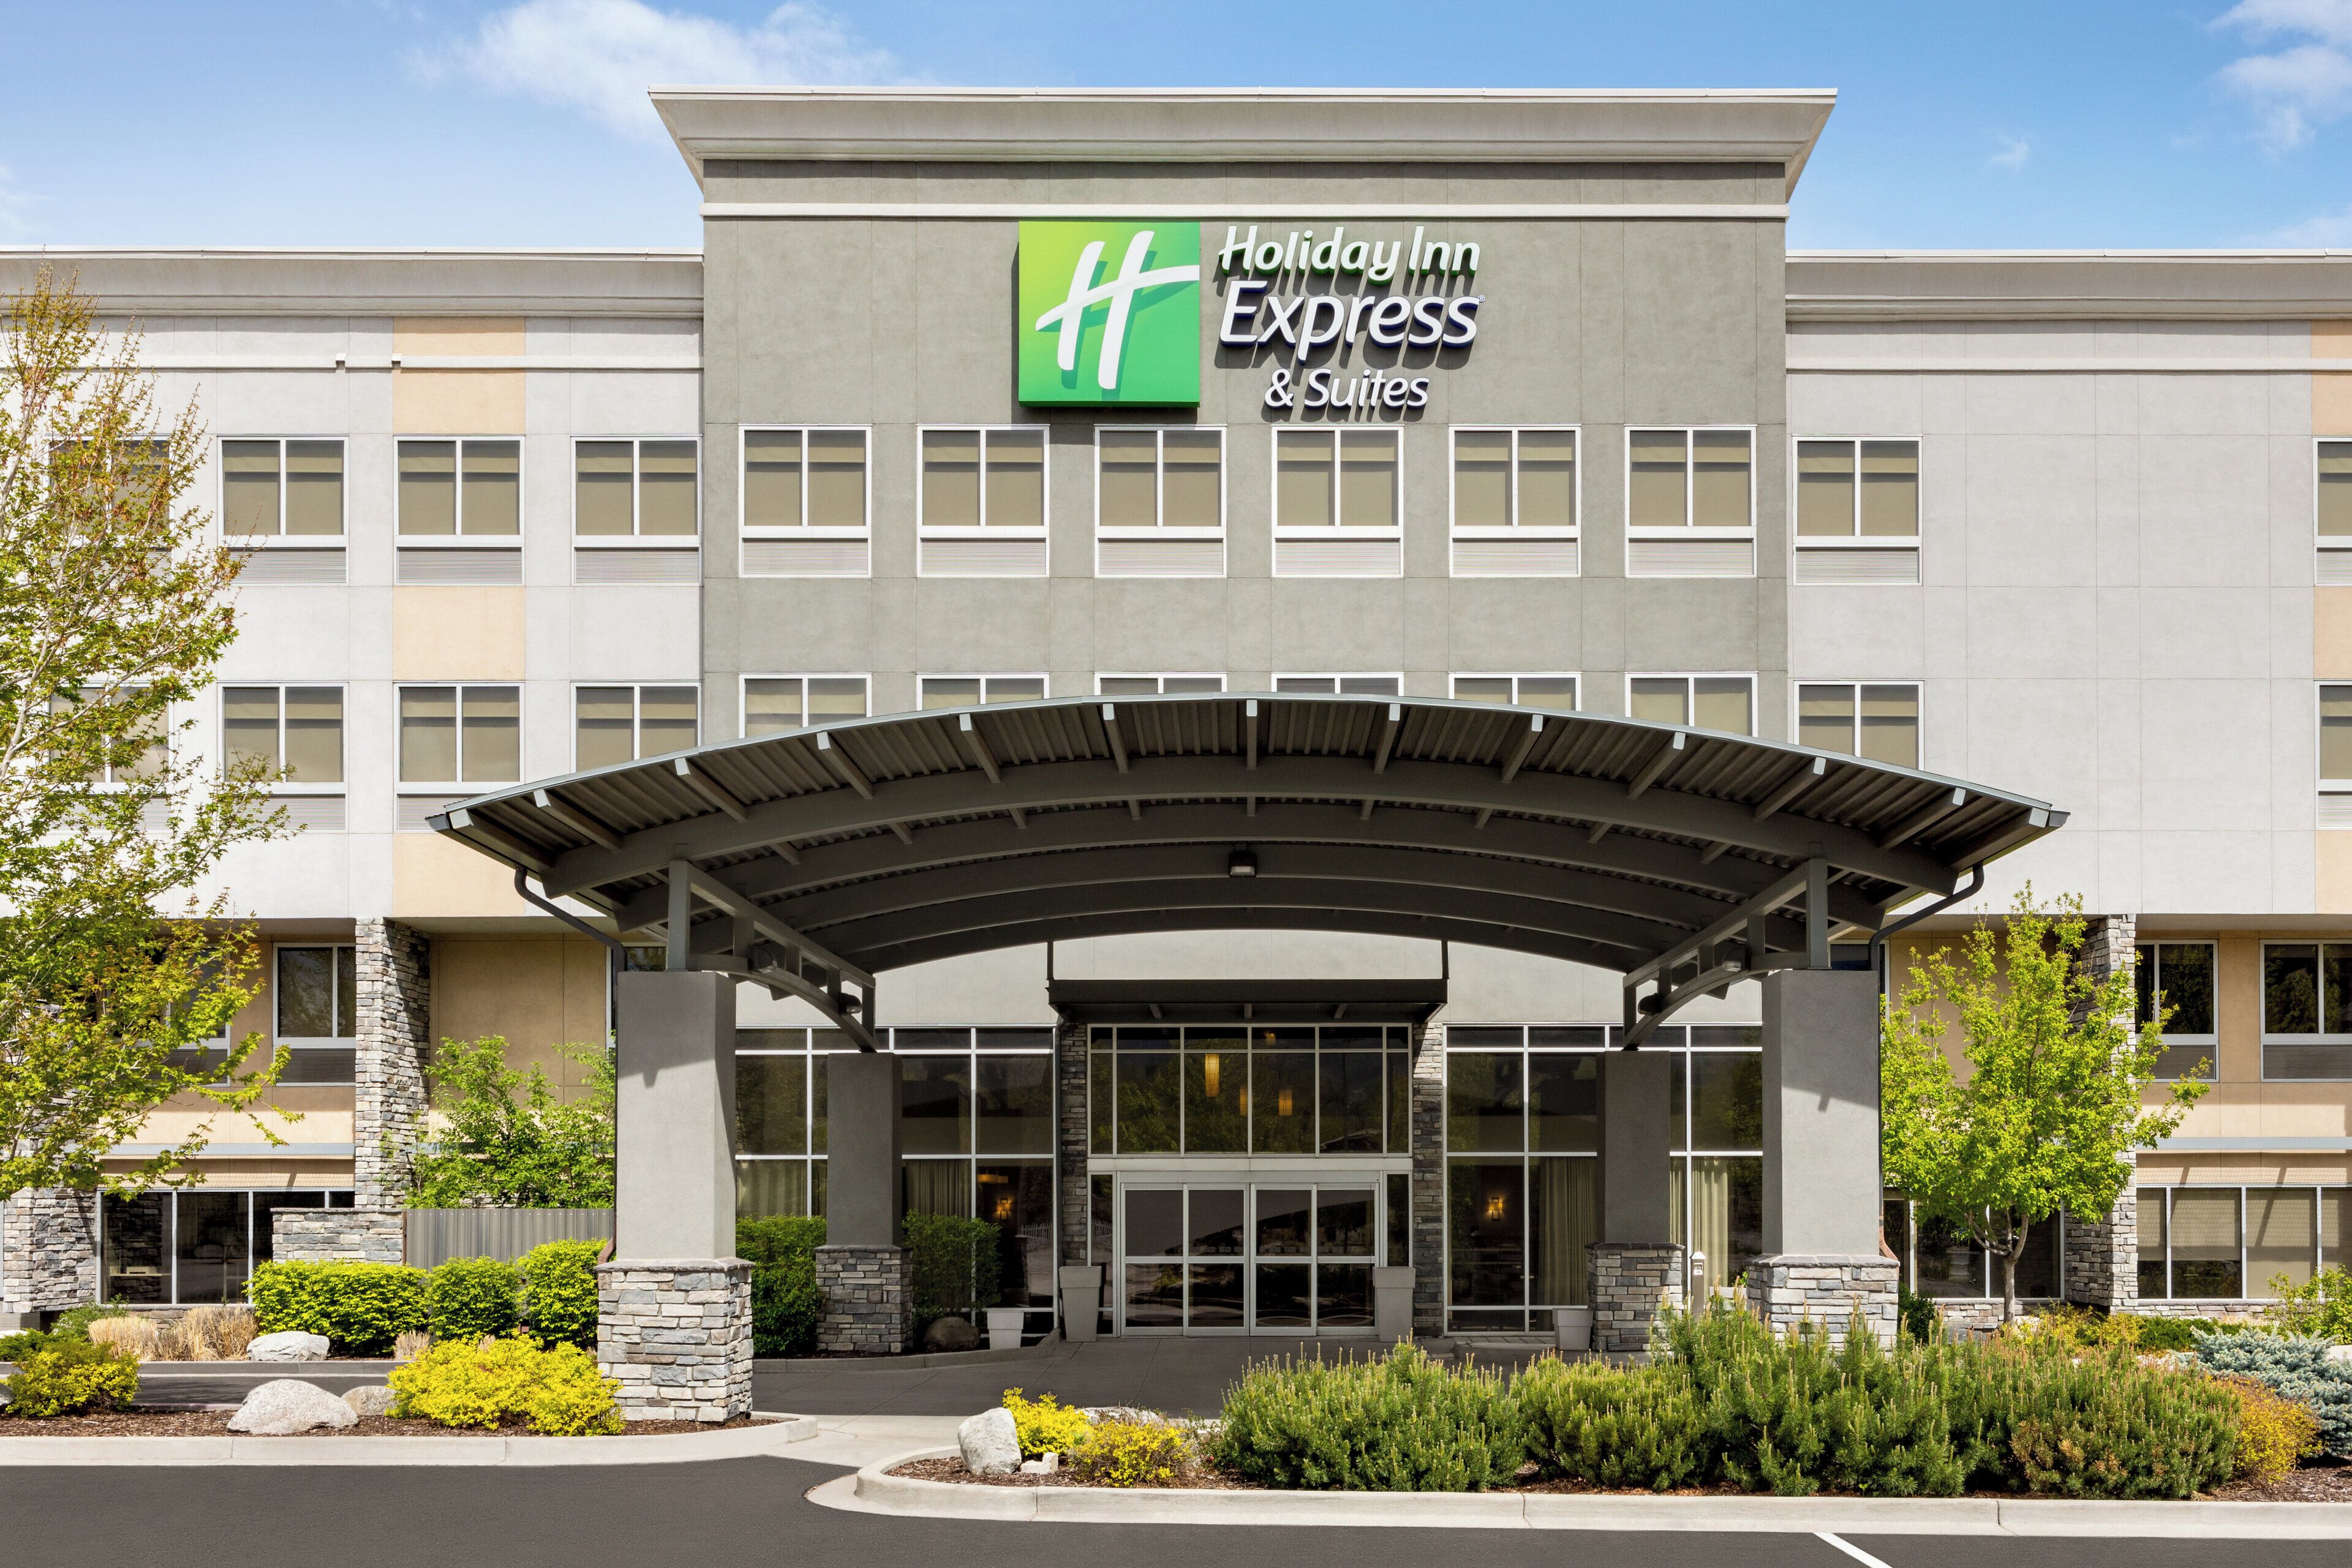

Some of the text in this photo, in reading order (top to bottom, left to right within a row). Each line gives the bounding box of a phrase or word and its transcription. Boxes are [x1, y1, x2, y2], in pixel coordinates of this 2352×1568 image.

[1218, 225, 1480, 284] Holiday Inn
[1035, 230, 1200, 390] H
[1264, 368, 1430, 408] & Suites
